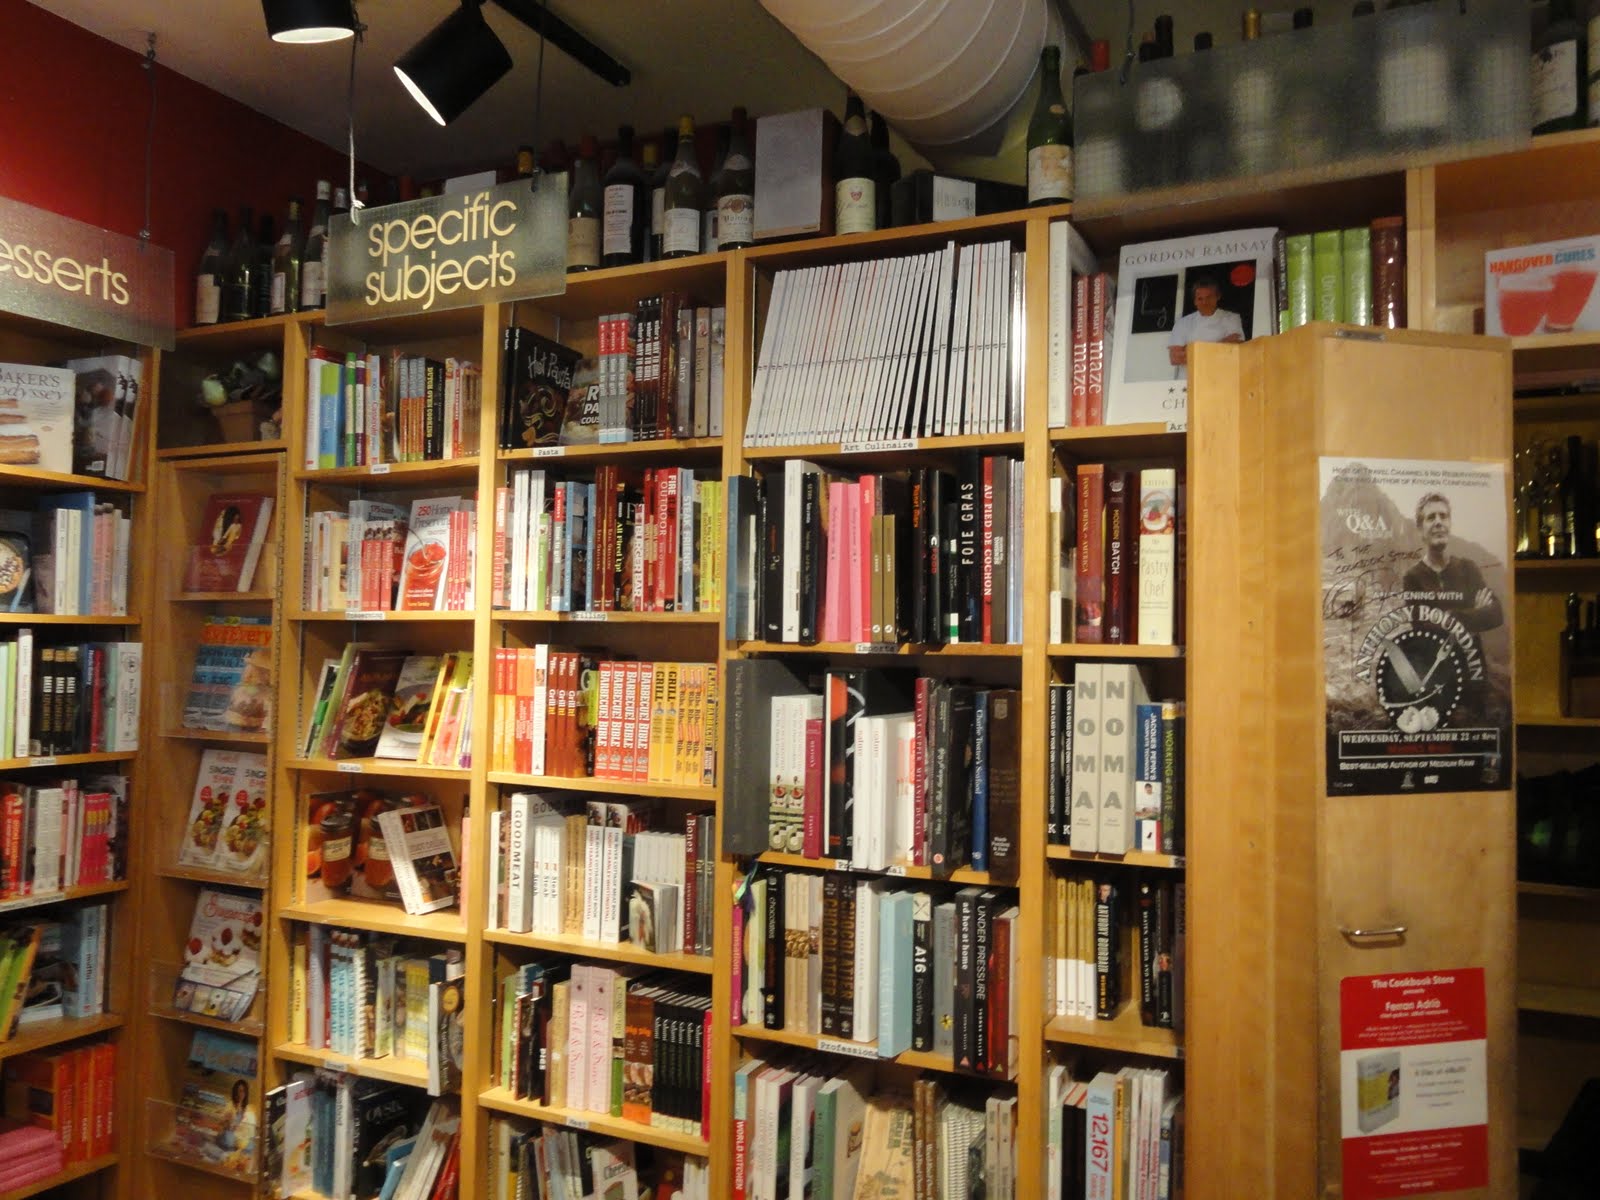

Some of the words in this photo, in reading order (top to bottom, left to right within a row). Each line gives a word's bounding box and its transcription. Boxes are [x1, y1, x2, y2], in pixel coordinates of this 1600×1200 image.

[367, 191, 517, 267] specific
[1125, 247, 1196, 265] GORDON
[1202, 239, 1269, 257] RAMSAY
[1489, 253, 1553, 273] HANGOVER
[1554, 248, 1595, 265] CURES
[365, 240, 516, 310] subjects
[679, 357, 688, 384] dairy
[1072, 342, 1087, 396] maze
[1089, 341, 1103, 394] maze
[843, 443, 860, 452] Art
[865, 441, 914, 451] Culinaire
[668, 475, 676, 495] FIRE
[984, 484, 993, 499] AU
[659, 481, 668, 536] OUTDOOR
[683, 495, 692, 526] STEAK
[961, 482, 974, 522] GRAS
[984, 502, 992, 528] PIED
[984, 531, 992, 546] DE
[1345, 514, 1388, 534] Q&A
[682, 530, 691, 573] FRIENDS
[961, 530, 974, 566] FOIE
[1113, 541, 1122, 574] BATCH
[984, 548, 992, 596] COCHON
[1437, 591, 1464, 600] WITH
[1356, 605, 1415, 684] ANTHONY
[1418, 604, 1484, 682] BOURDAIN
[599, 670, 611, 719] BARBECUE!
[612, 670, 624, 719] BARBECUE!
[625, 671, 637, 720] BARBECUE!
[640, 672, 652, 720] BARBECUE!
[655, 670, 664, 702] GRILL
[667, 670, 677, 702] GRILL
[598, 720, 608, 747] BIBLE
[611, 721, 622, 748] BIBLE
[623, 722, 634, 748] BIBLE
[638, 724, 649, 750] BIBLE
[1403, 733, 1458, 743] SEPTEMBER
[1164, 730, 1174, 776] WORKING
[1164, 785, 1172, 811] PLATE
[686, 818, 696, 853] Bones
[962, 902, 970, 914] ad
[977, 905, 986, 942] UNDER
[1098, 904, 1109, 936] ANTHONY
[962, 933, 969, 942] at
[914, 946, 926, 973] A16
[1098, 938, 1108, 973] BOURDAIN
[976, 945, 985, 1000] PRESSURE
[820, 1041, 878, 1057] Professiona
[736, 1121, 745, 1152] WORLD
[1092, 1113, 1108, 1173] 12,167
[734, 1153, 744, 1190] KITCHEN
